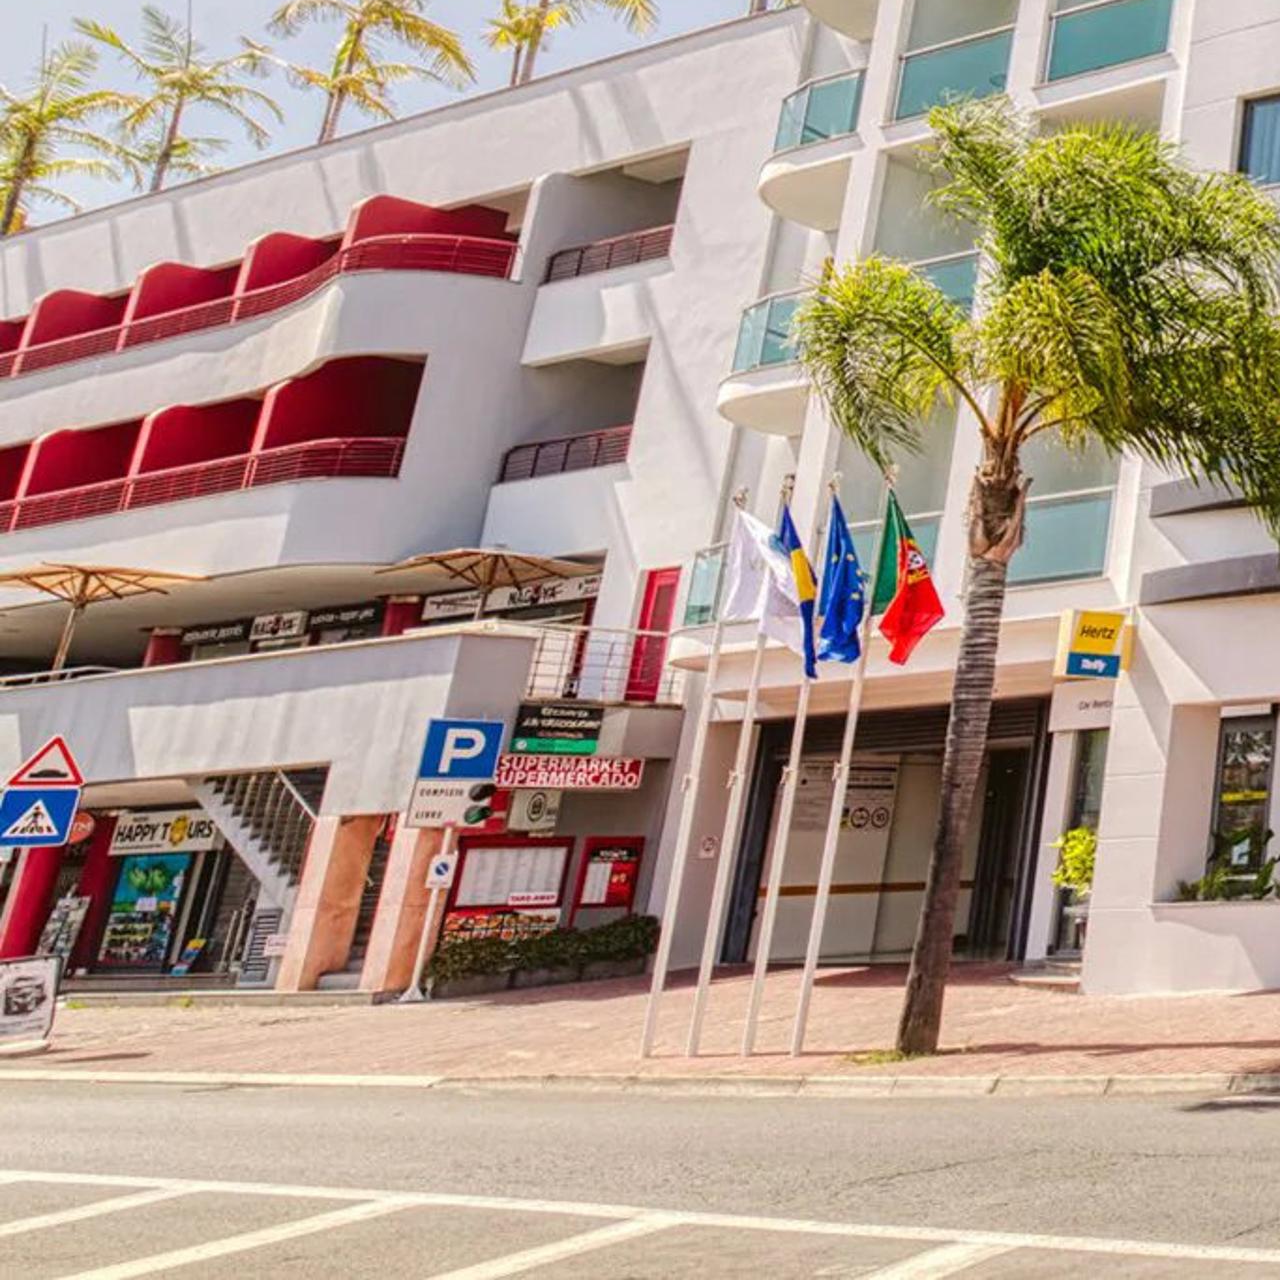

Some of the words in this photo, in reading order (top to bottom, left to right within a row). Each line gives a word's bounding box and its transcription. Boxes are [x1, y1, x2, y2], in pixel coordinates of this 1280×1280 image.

[1079, 624, 1116, 640] Hertz
[437, 727, 487, 774] P
[499, 756, 632, 771] SUPERMARKET
[114, 822, 159, 843] HAPPY
